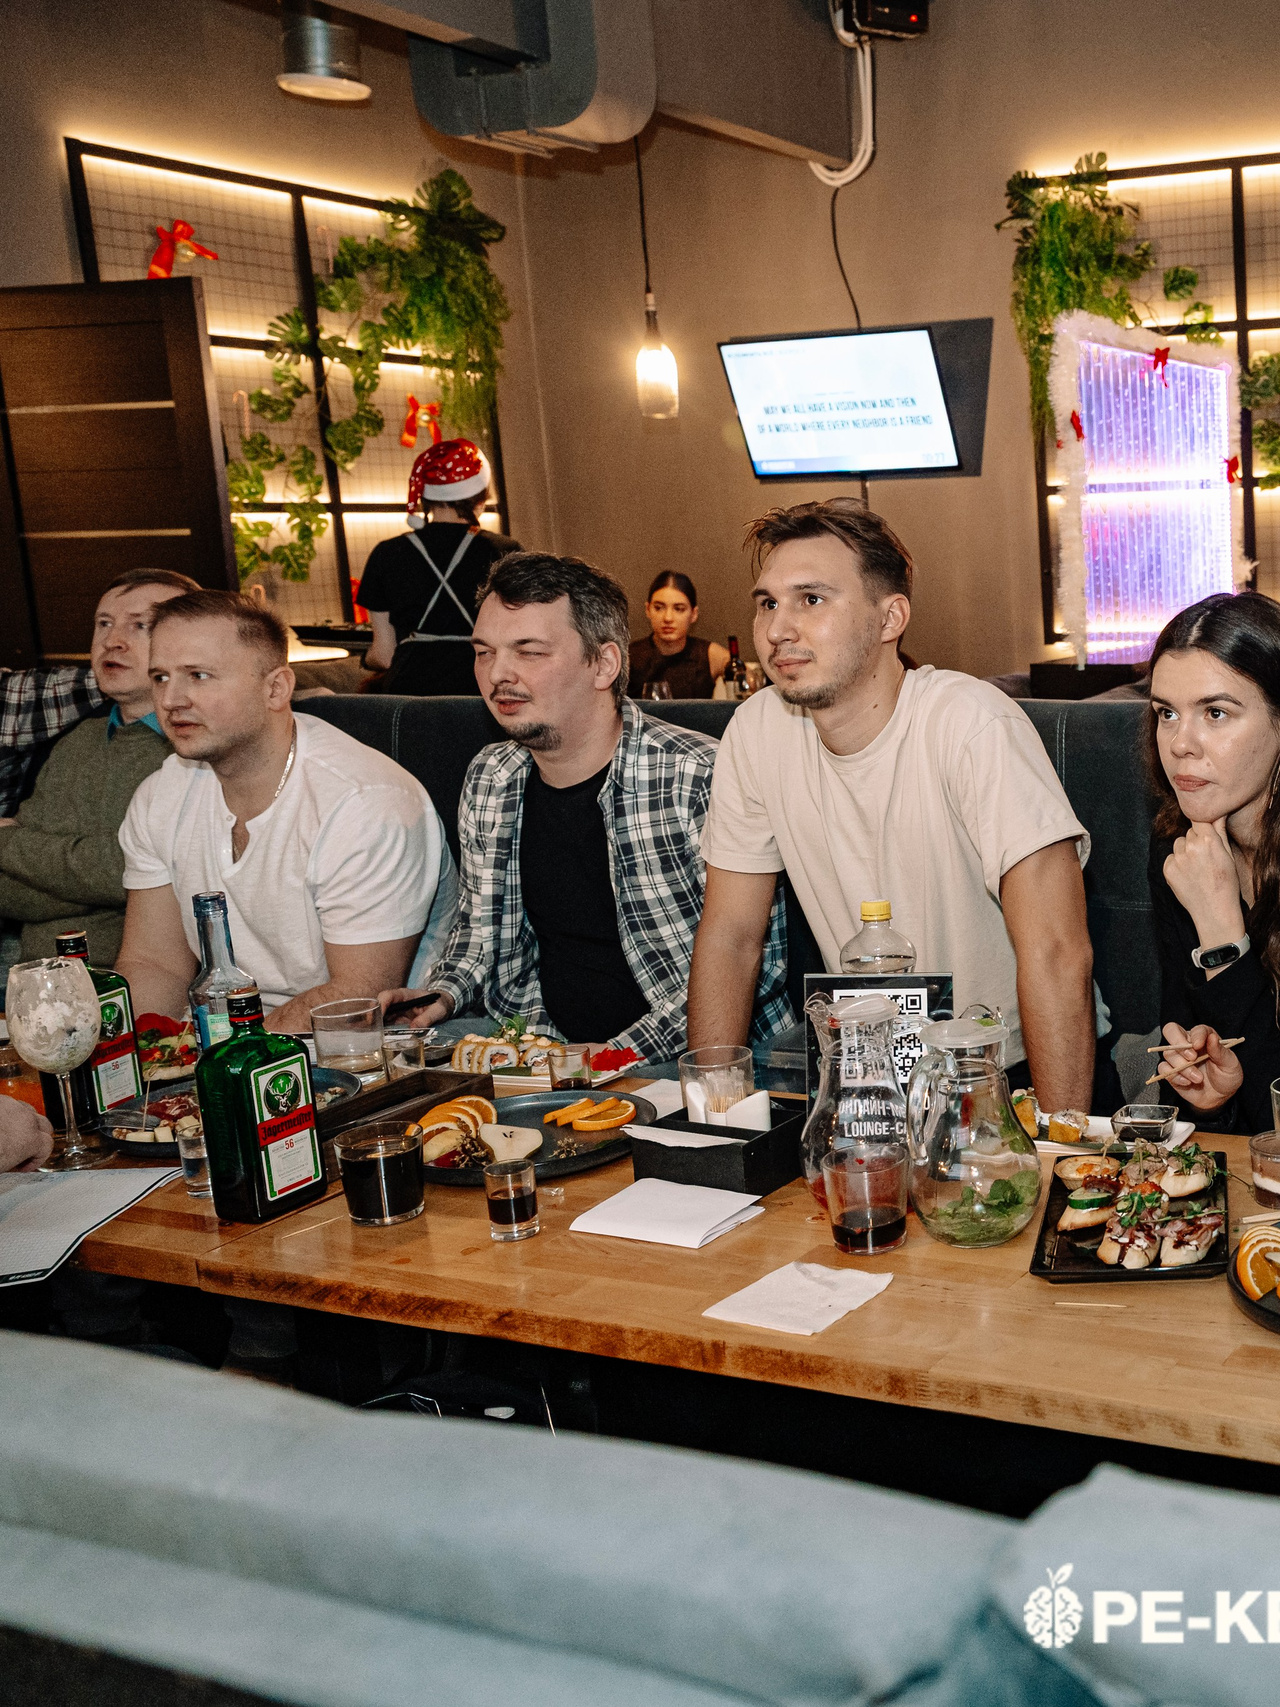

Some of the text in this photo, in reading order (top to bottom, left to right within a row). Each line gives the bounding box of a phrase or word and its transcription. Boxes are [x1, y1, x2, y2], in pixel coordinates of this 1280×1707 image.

[763, 405, 778, 415] MAY
[781, 404, 792, 414] WE
[808, 402, 826, 413] HAVE
[836, 400, 860, 411] VISION
[861, 399, 878, 409] NOW
[880, 398, 895, 408] AND
[896, 397, 917, 407] THEN
[757, 423, 766, 434] OF
[775, 422, 799, 433] WORLD
[801, 420, 826, 431] WHERE
[827, 419, 850, 430] EVERY
[852, 417, 889, 429] NEIGHBOR
[906, 414, 933, 426] FRIEND
[112, 1060, 119, 1070] 56
[261, 1110, 312, 1141] Jägermeister
[285, 1138, 294, 1150] 56
